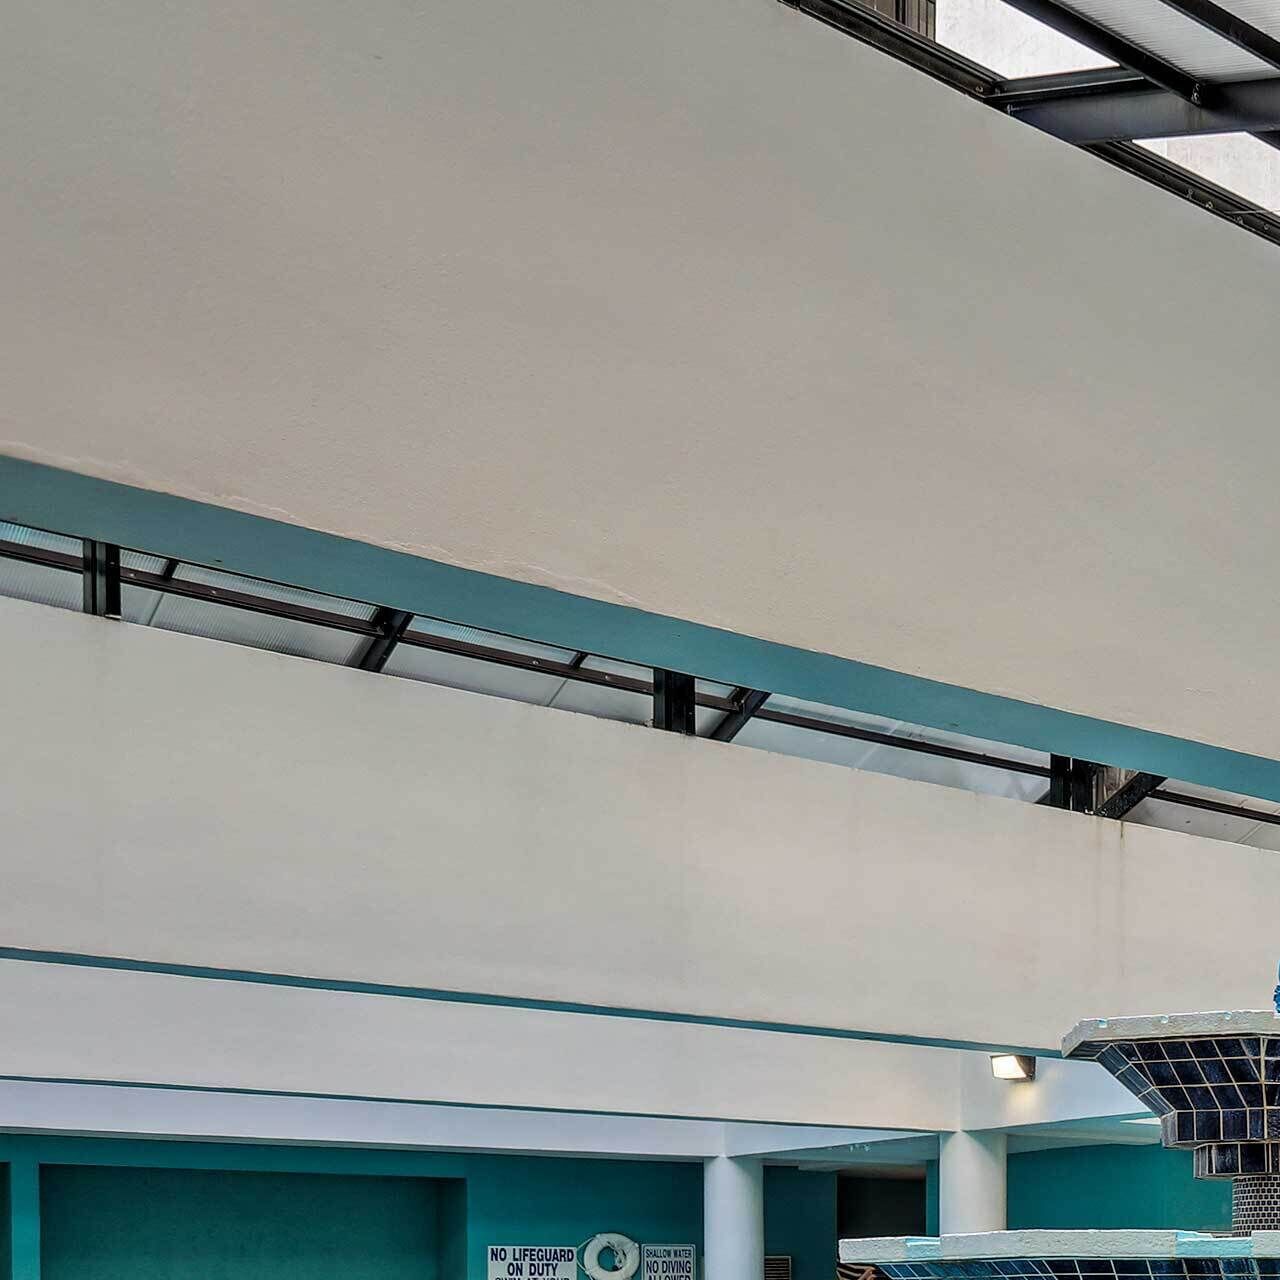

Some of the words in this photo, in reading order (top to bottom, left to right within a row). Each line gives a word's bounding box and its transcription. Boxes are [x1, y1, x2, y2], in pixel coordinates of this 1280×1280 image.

[490, 1247, 507, 1262] NO
[512, 1247, 575, 1262] LIFEGUARD
[645, 1248, 672, 1258] SHALLOW
[673, 1249, 692, 1258] WATER
[507, 1262, 523, 1277] ON
[528, 1262, 558, 1277] DUTY
[646, 1260, 659, 1274] NO
[661, 1260, 692, 1274] DIVING
